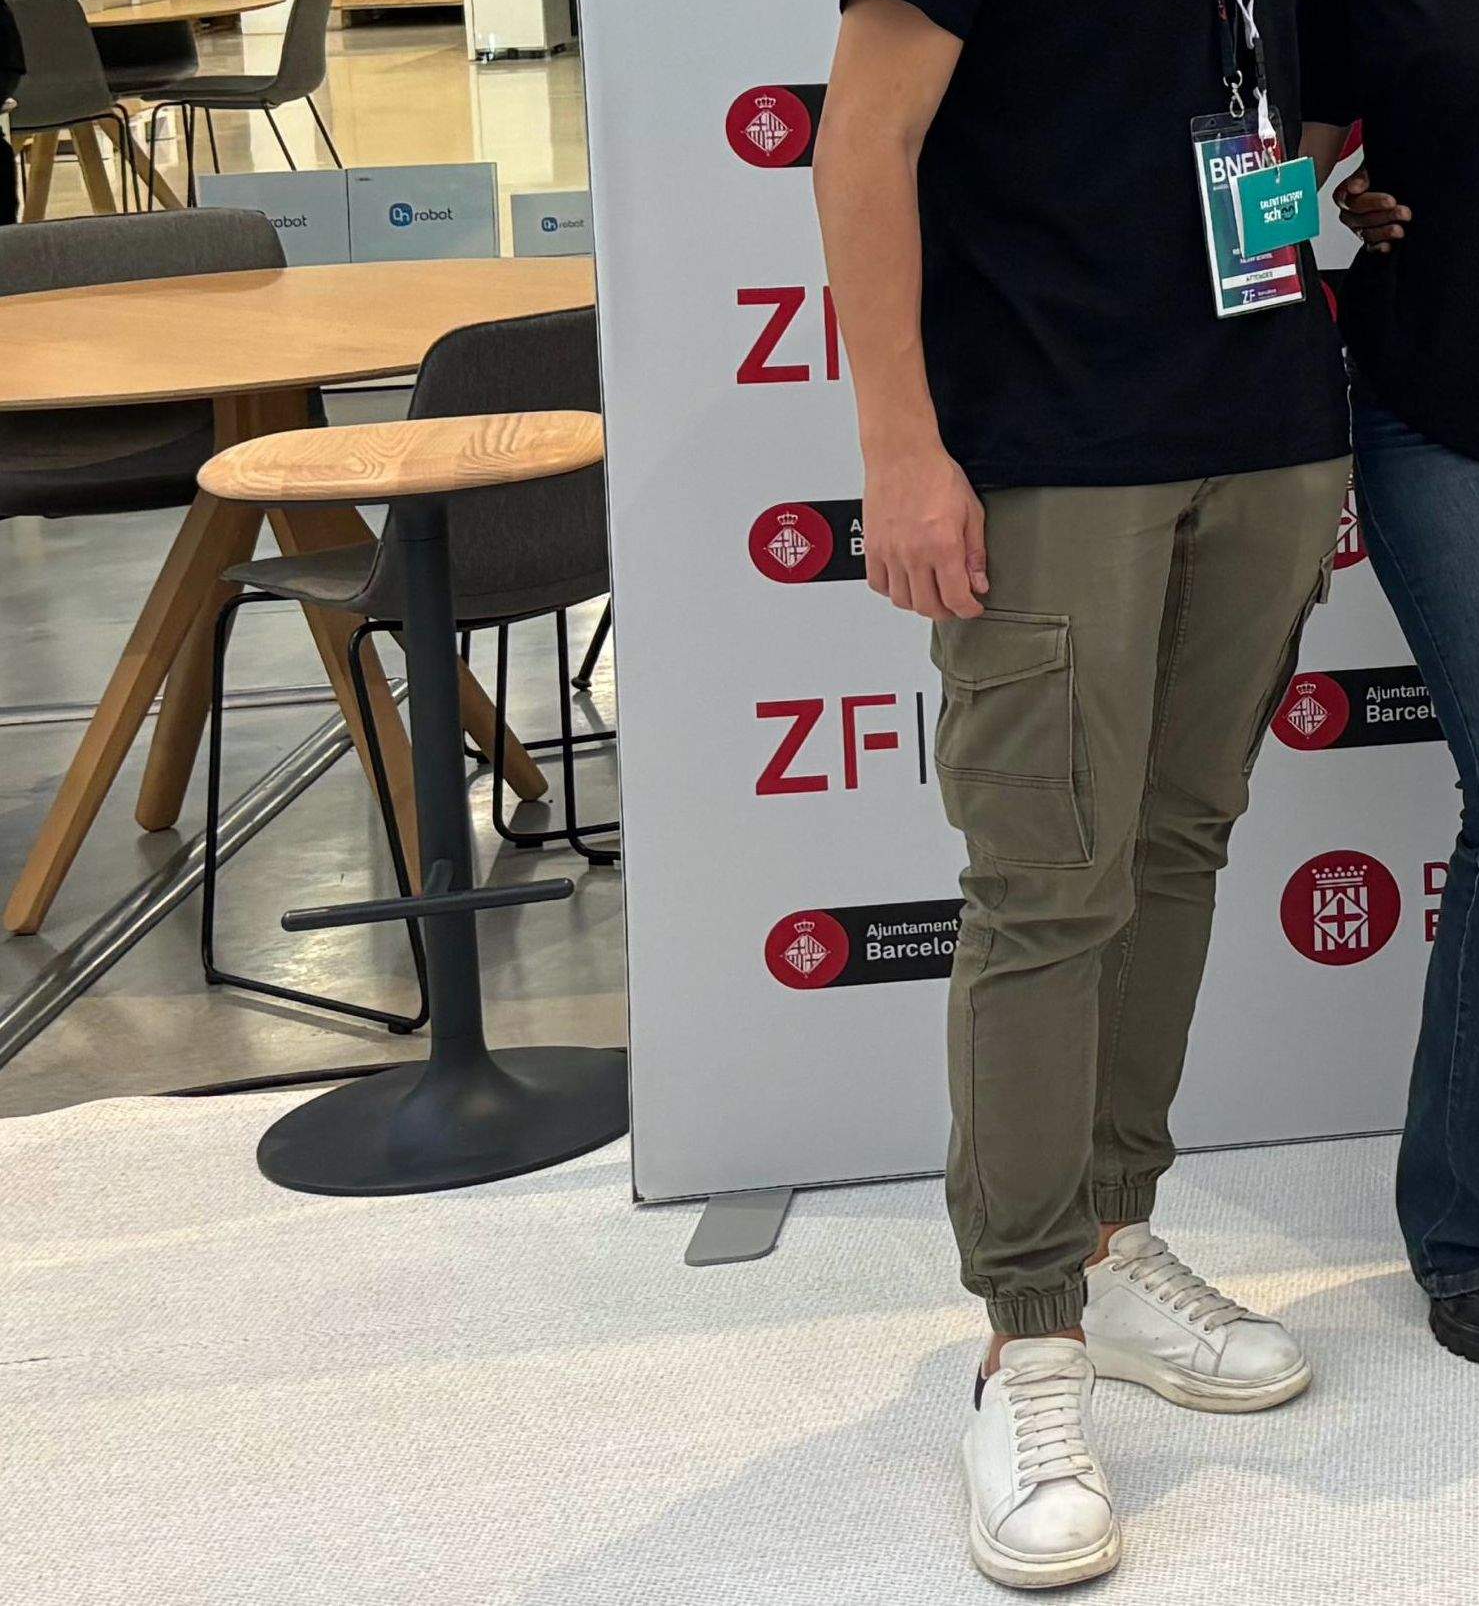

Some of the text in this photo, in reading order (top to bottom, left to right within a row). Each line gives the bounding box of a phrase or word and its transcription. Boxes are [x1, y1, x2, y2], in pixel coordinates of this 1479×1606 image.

[1366, 686, 1430, 703] Ajuntam
[1366, 700, 1436, 723] Barcel
[756, 694, 898, 795] ZF
[866, 918, 958, 939] Ajuntament
[866, 936, 960, 961] Barcelo
